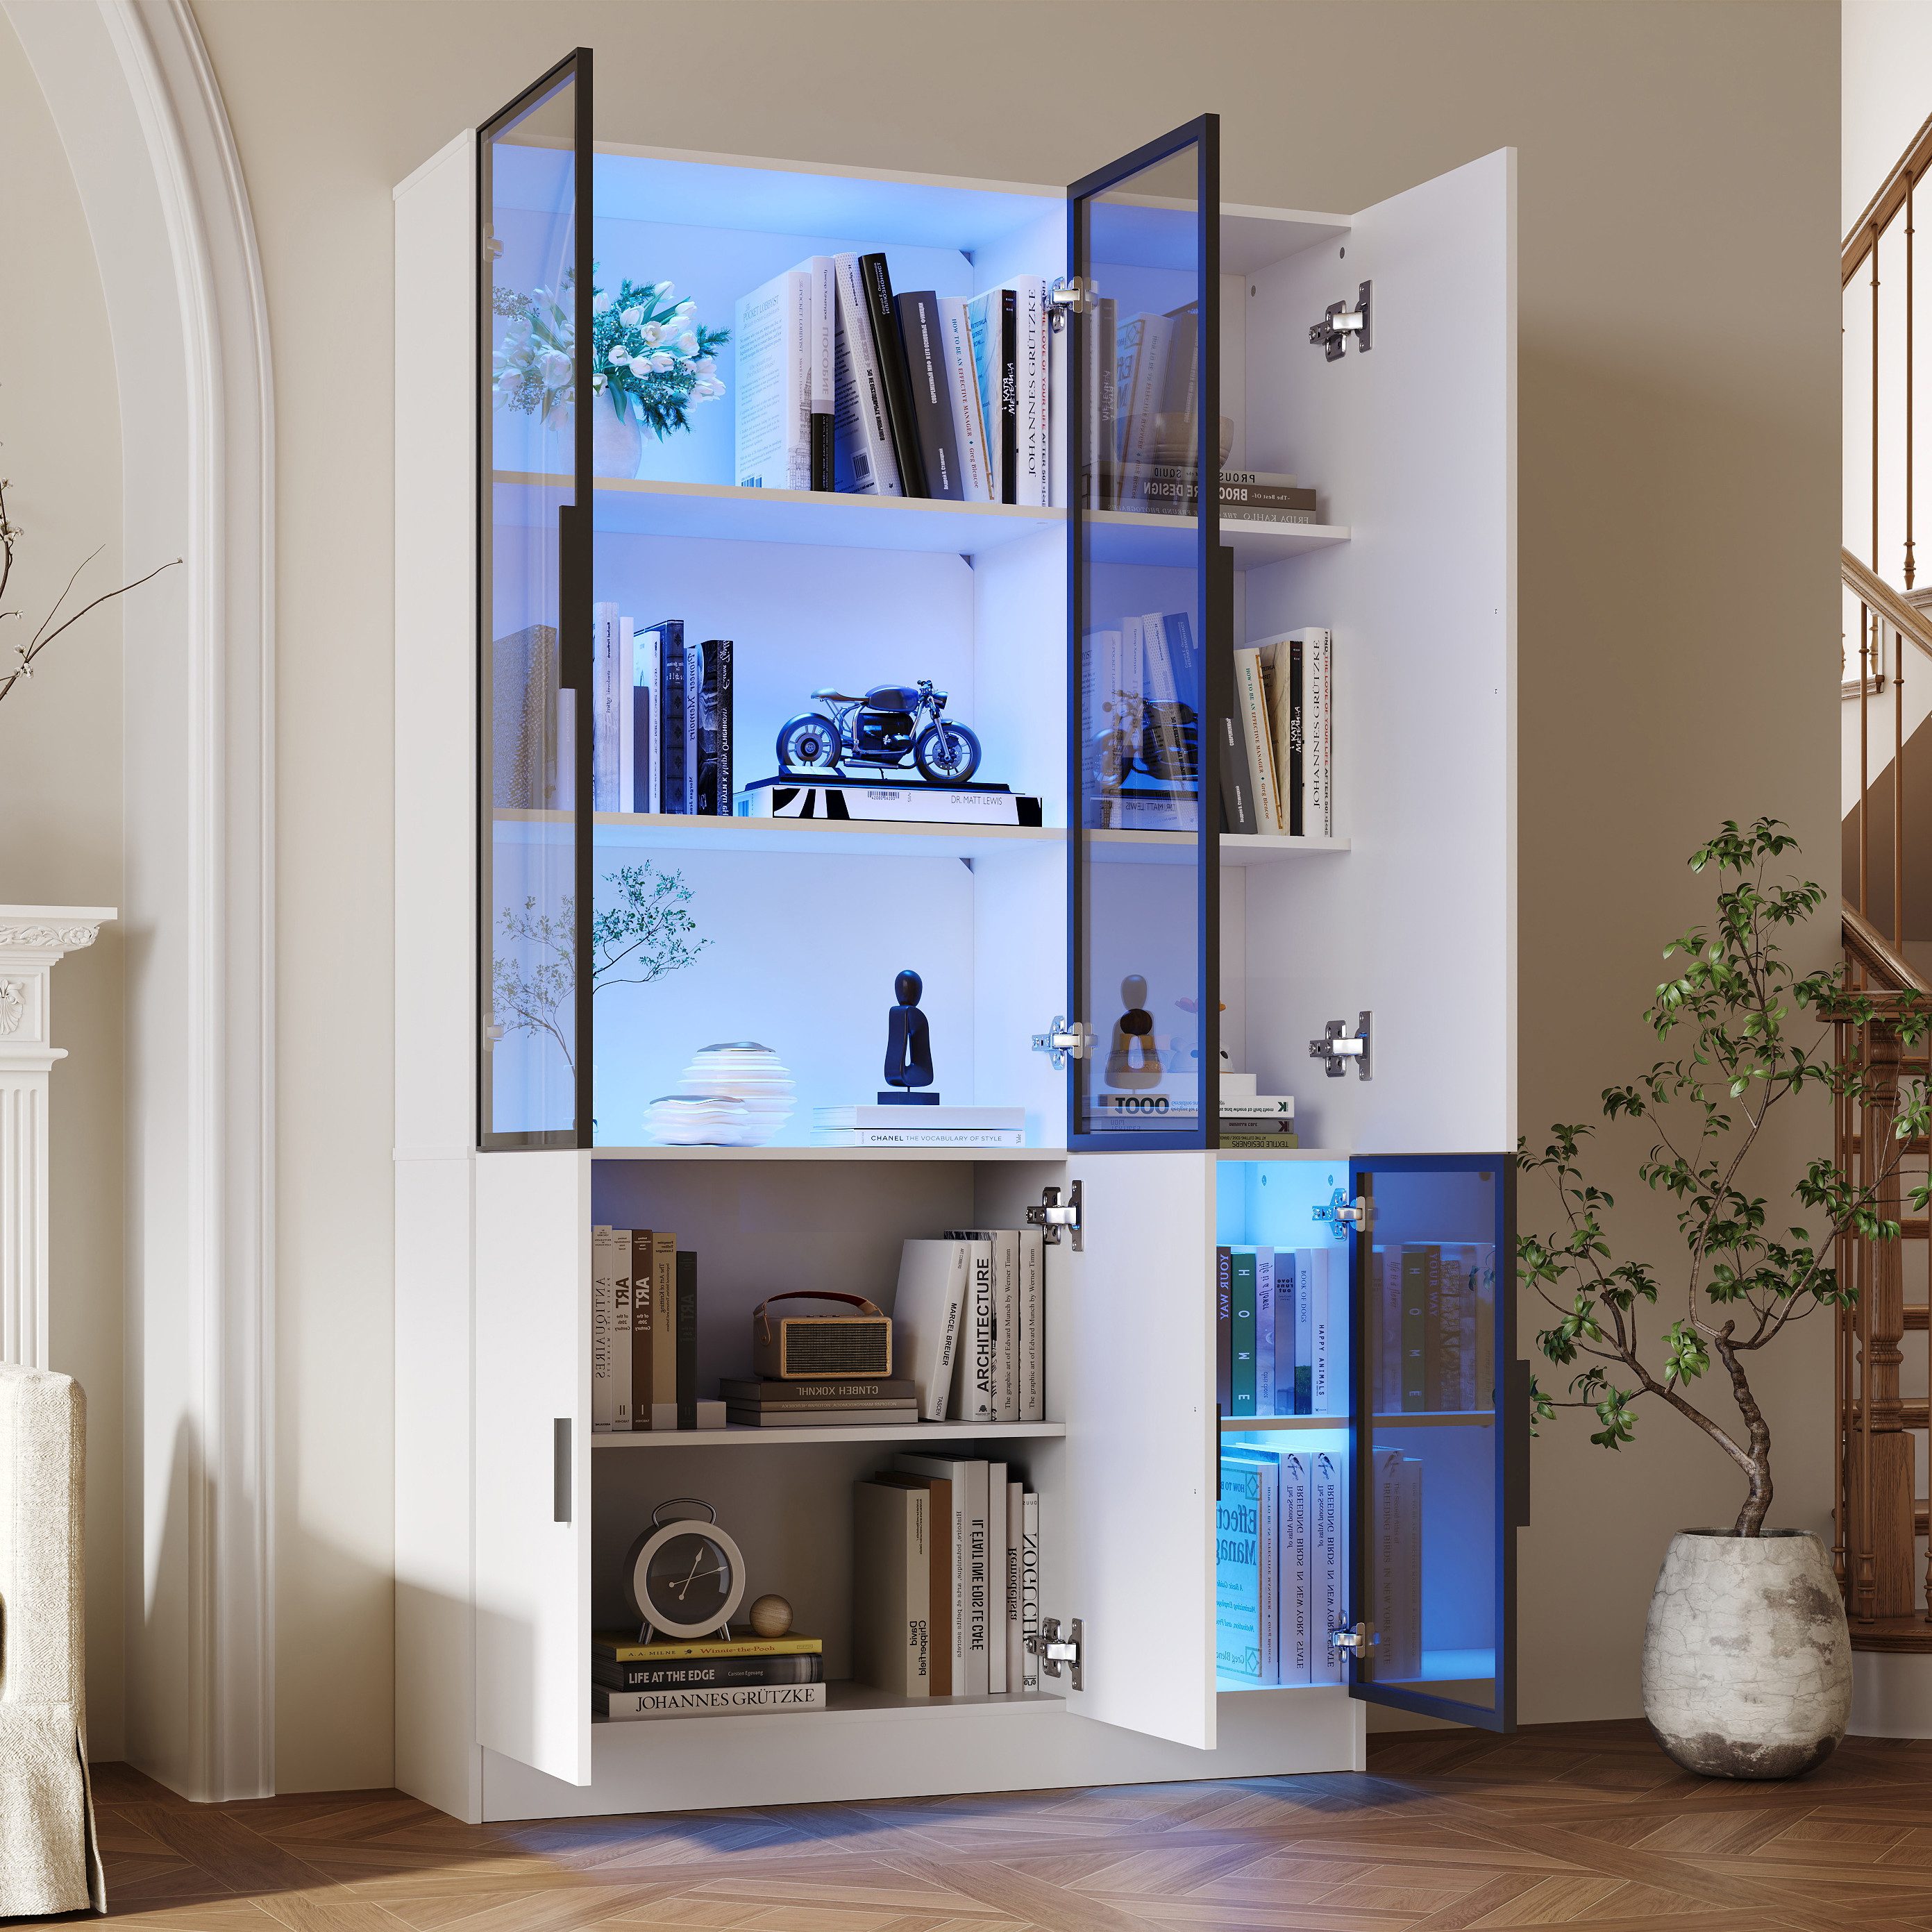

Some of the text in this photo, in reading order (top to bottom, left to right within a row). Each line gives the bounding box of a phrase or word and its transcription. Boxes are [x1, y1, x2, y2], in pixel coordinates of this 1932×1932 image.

[877, 262, 890, 314] ИЛЛЮЗИОНИСТ
[1027, 289, 1036, 376] GRÜTZKE
[927, 372, 937, 404] СОВРЕМЕННЫЙ
[959, 368, 972, 437] EFFECTIVE MANAGER
[875, 416, 885, 441] НАВЫКОВ
[1252, 712, 1260, 743] EFFECTIVE
[1294, 706, 1302, 753] МЕТЕЛИЦА
[964, 796, 1002, 805] MATT LEWIS
[1429, 1253, 1440, 1287] YOUR
[1005, 1294, 1012, 1303] by
[1029, 1293, 1036, 1302] by
[1301, 1292, 1307, 1302] OF
[942, 1302, 957, 1366] MARCEL BREUER
[977, 1258, 989, 1393] ARCHITECTURE
[1029, 1352, 1035, 1360] of
[700, 1645, 775, 1654] Winnie-the-Pooh
[628, 1669, 715, 1684] LIFE AT THE EDGE
[745, 1670, 764, 1678] Egevang
[636, 1688, 815, 1712] JOHANNES GRÜTZKE
